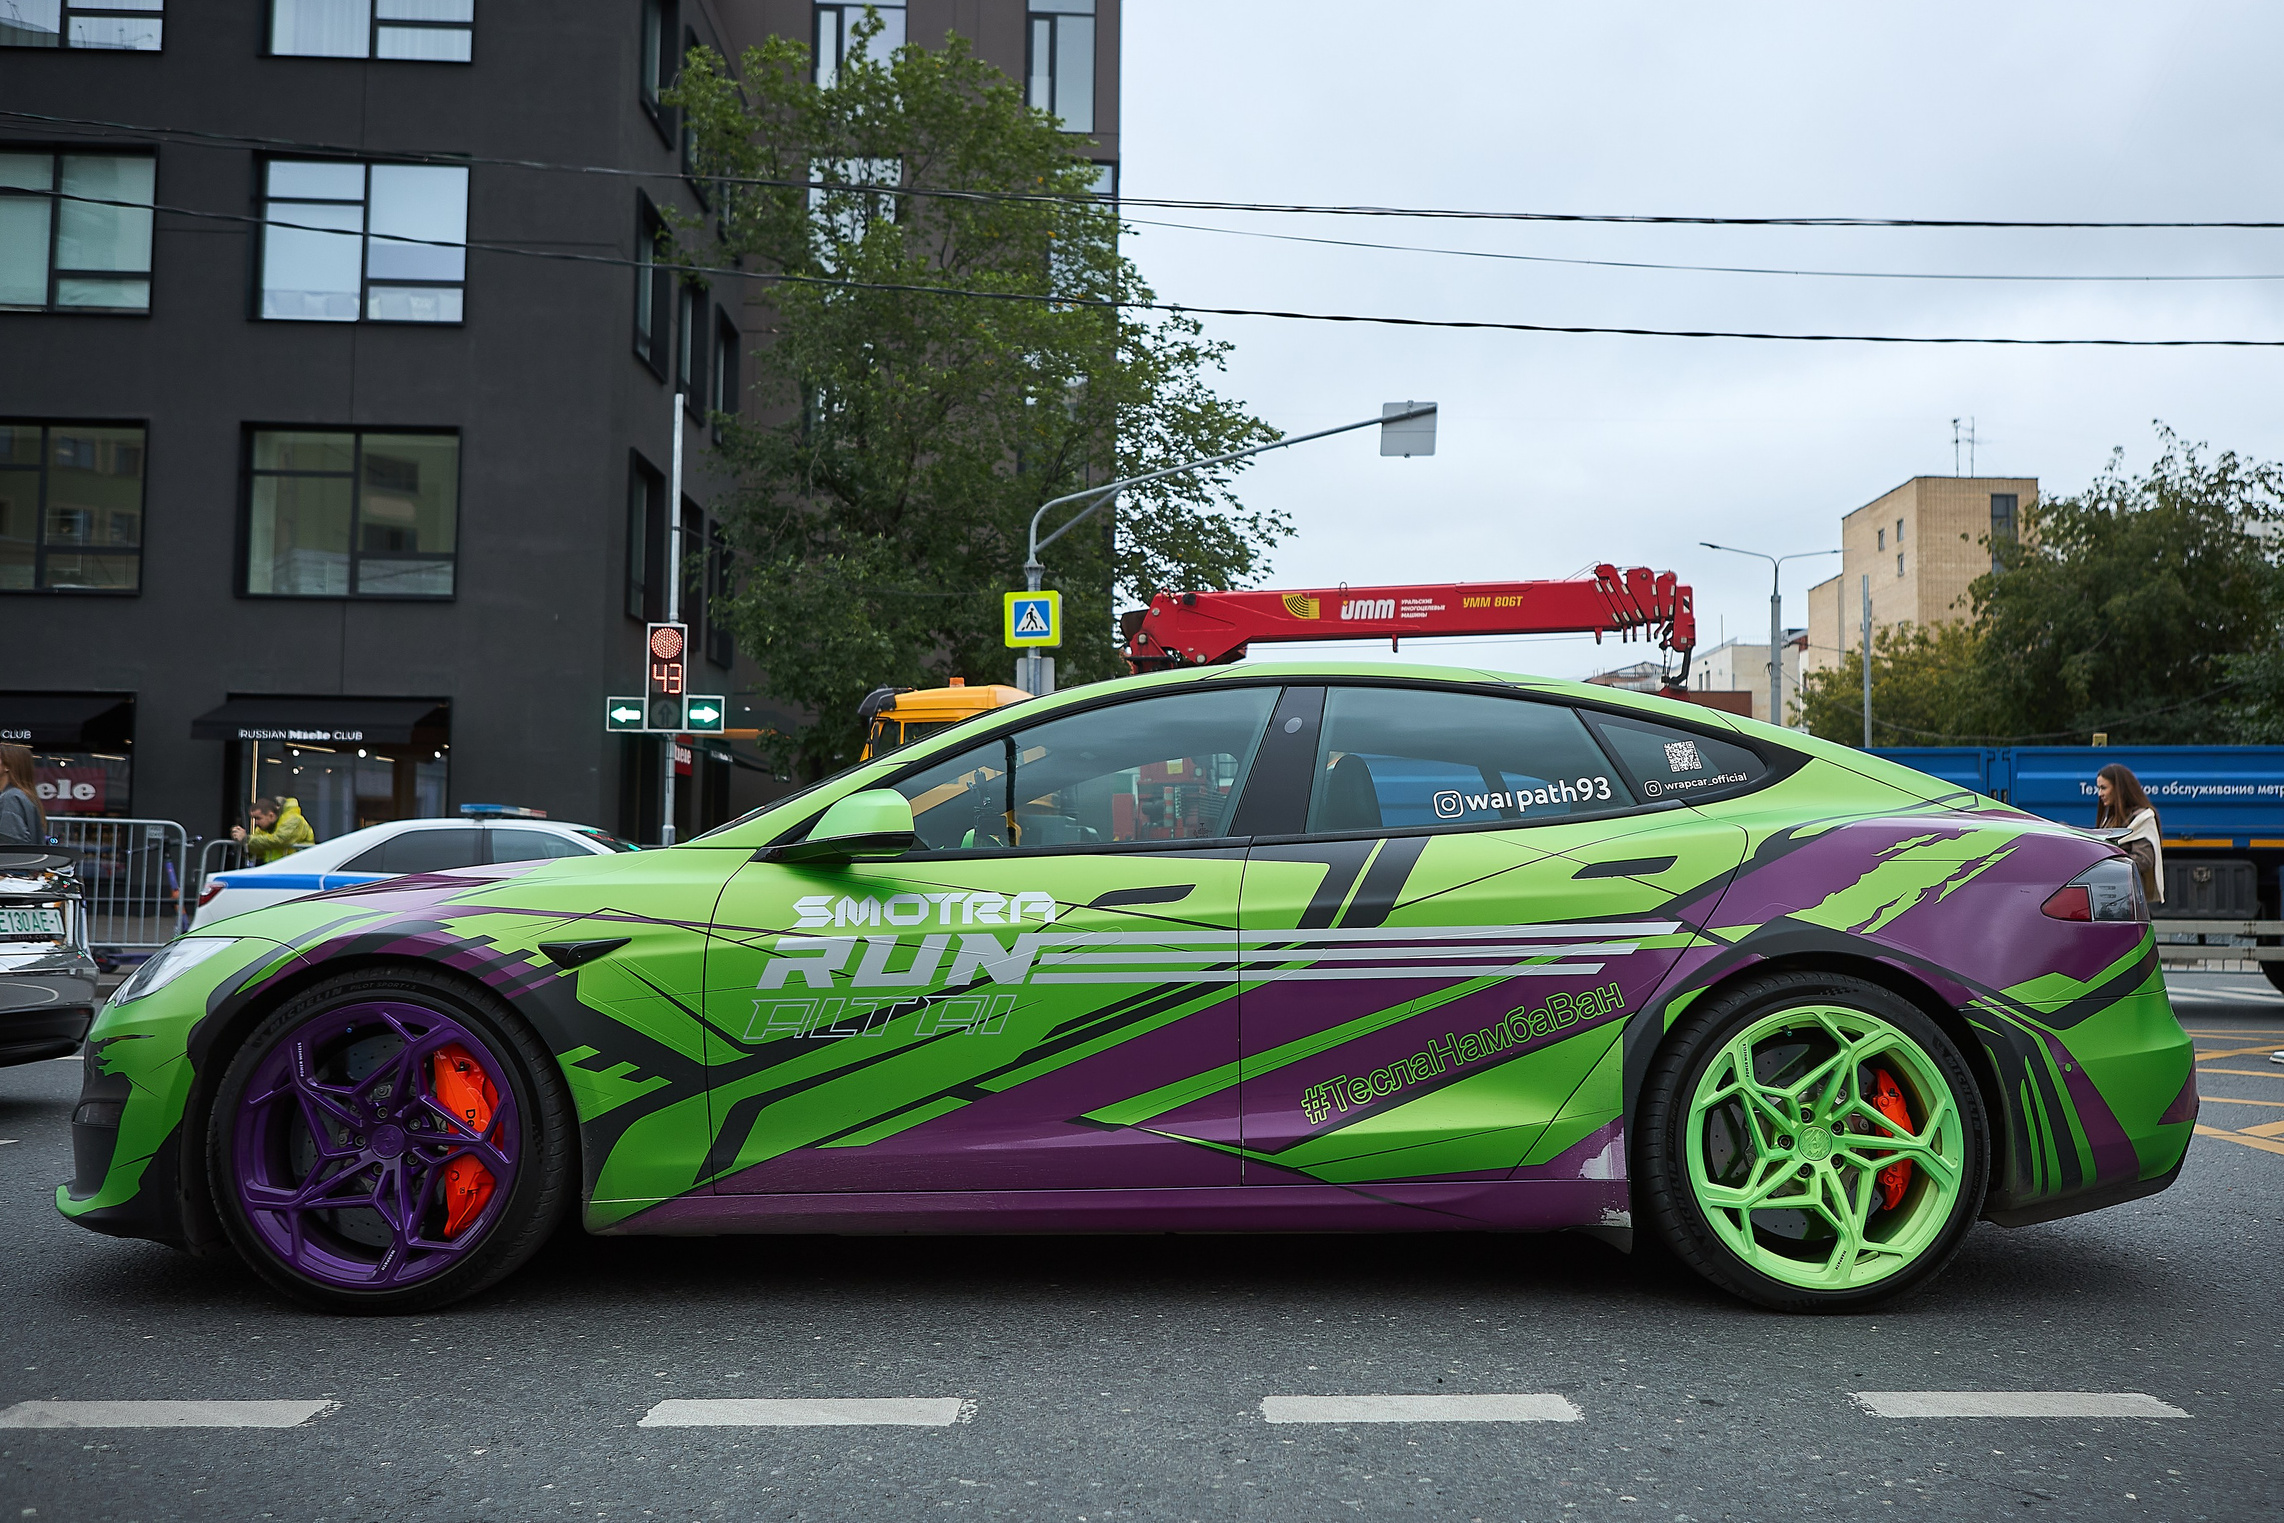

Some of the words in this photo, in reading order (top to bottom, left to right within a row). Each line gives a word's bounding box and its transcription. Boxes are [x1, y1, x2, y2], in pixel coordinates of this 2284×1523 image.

[1463, 597, 1491, 608] УММ
[652, 663, 682, 694] 43
[1, 730, 32, 739] CLUB
[239, 729, 287, 739] RUSSIAN
[333, 730, 363, 740] CLUB
[35, 779, 97, 800] ele
[1664, 772, 1747, 790] wrapcar_official
[2162, 781, 2255, 798] обслуживание
[792, 891, 1056, 928] SMOTRA
[756, 932, 1041, 989] RUN
[270, 987, 342, 1032] MICHELIN
[350, 982, 374, 990] PILOT
[743, 994, 1017, 1039] ALTAI
[1301, 982, 1625, 1125] #ТеслаНамбаВан
[1946, 1053, 1981, 1131] MICHELIN
